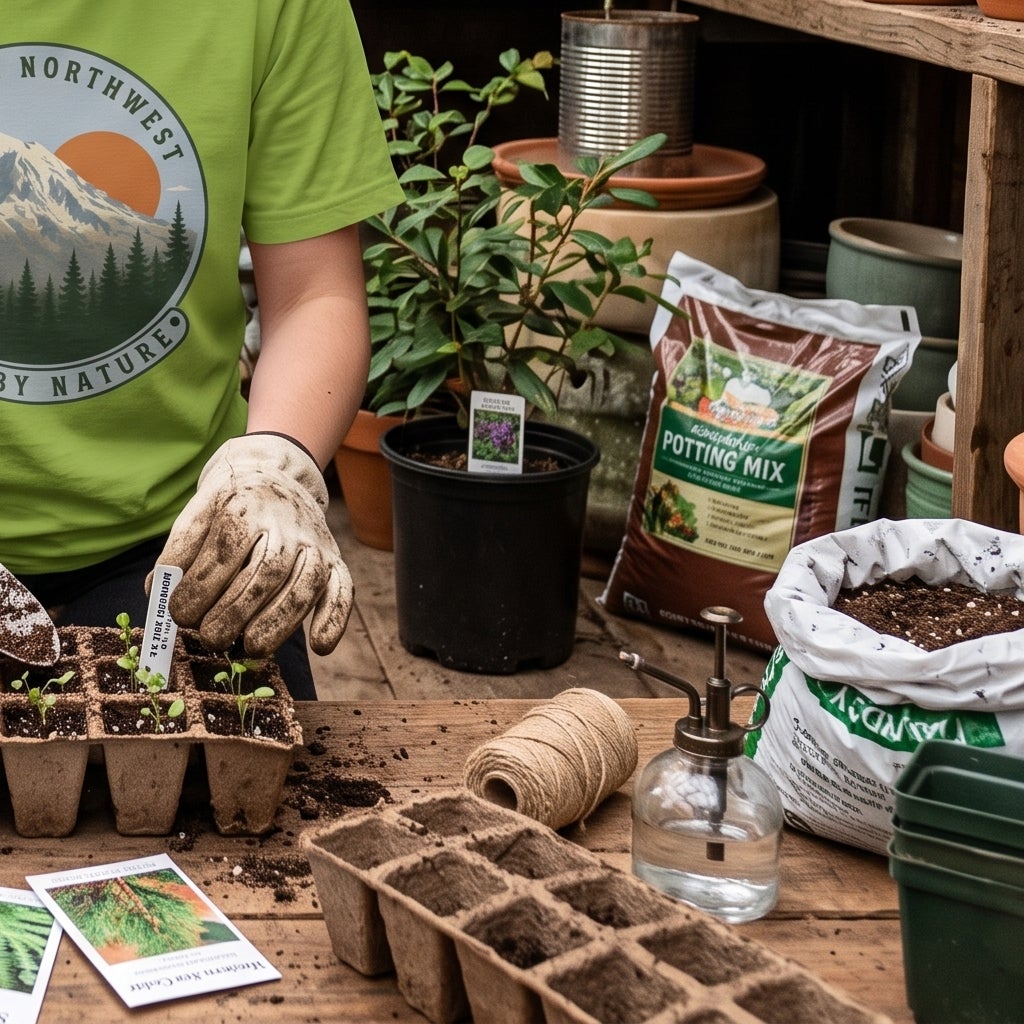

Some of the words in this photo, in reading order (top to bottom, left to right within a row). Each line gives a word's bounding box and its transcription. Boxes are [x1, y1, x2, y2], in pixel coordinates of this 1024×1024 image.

[20, 55, 184, 161] NORTHWEST
[51, 327, 173, 397] NATURE
[662, 429, 738, 473] POTTING
[743, 455, 786, 484] MIX
